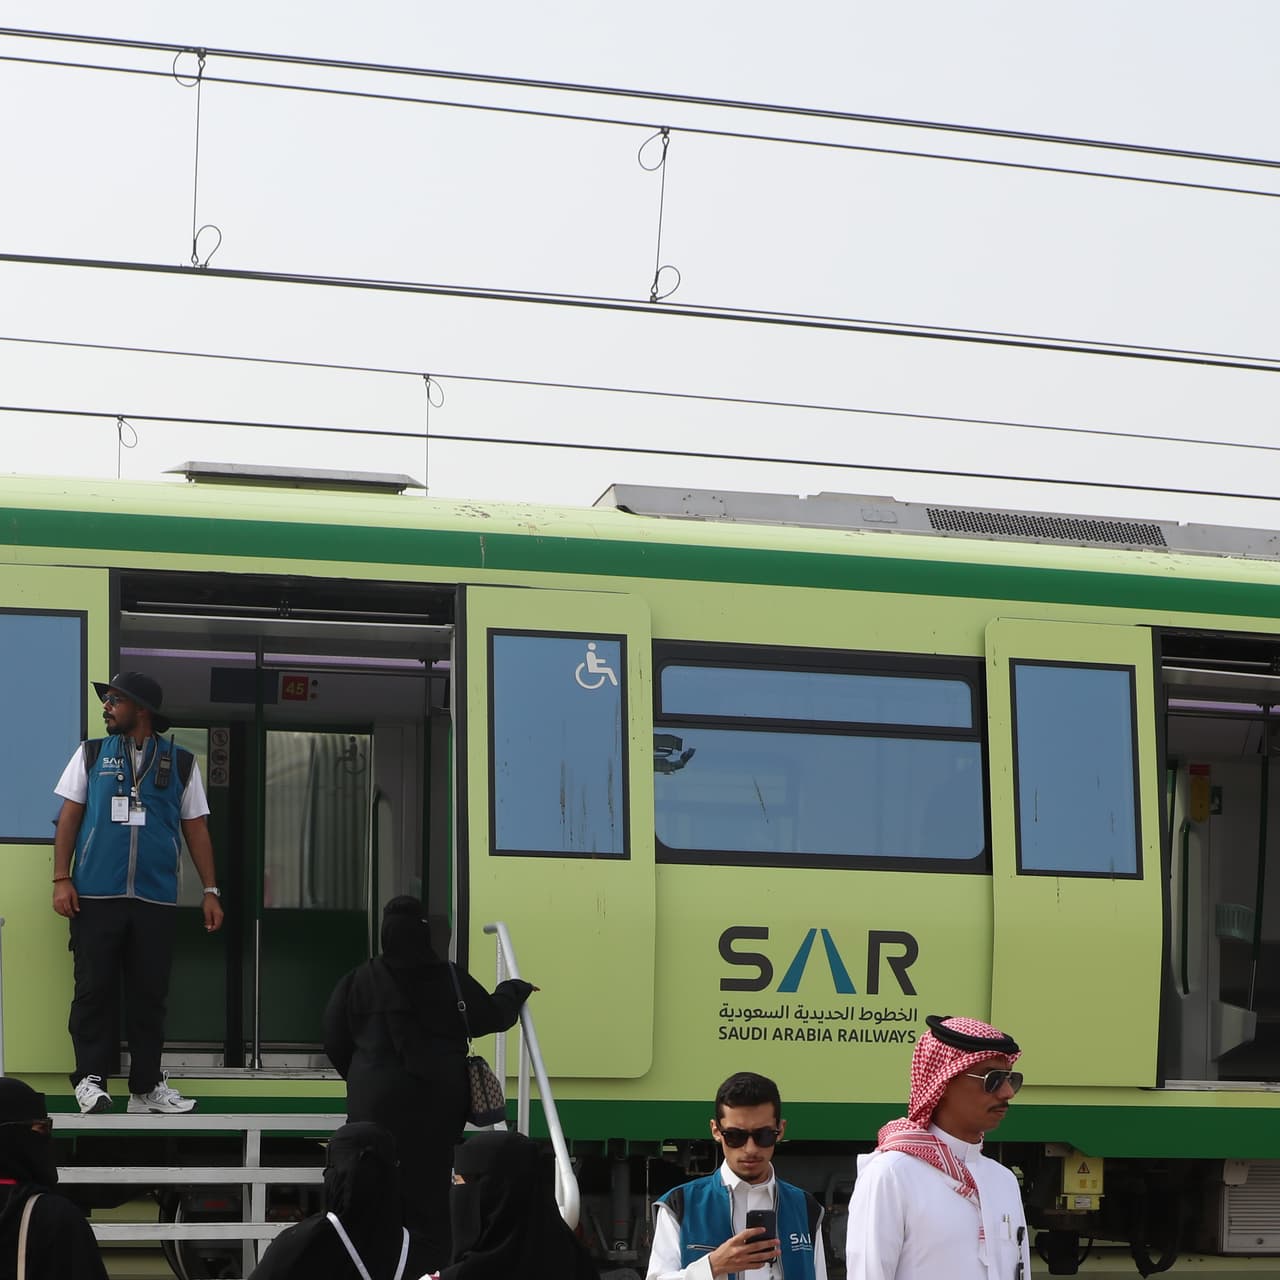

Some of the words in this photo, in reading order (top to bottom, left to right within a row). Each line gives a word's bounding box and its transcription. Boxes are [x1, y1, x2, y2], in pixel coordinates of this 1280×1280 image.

[286, 681, 305, 695] 45
[718, 925, 919, 996] SAR
[719, 1002, 789, 1022] السعودية
[794, 1004, 855, 1024] الحديدية
[858, 1007, 918, 1025] الخطوط
[718, 1026, 767, 1041] SAUDI
[772, 1027, 833, 1042] ARABIA
[837, 1028, 917, 1044] RAILWAYS
